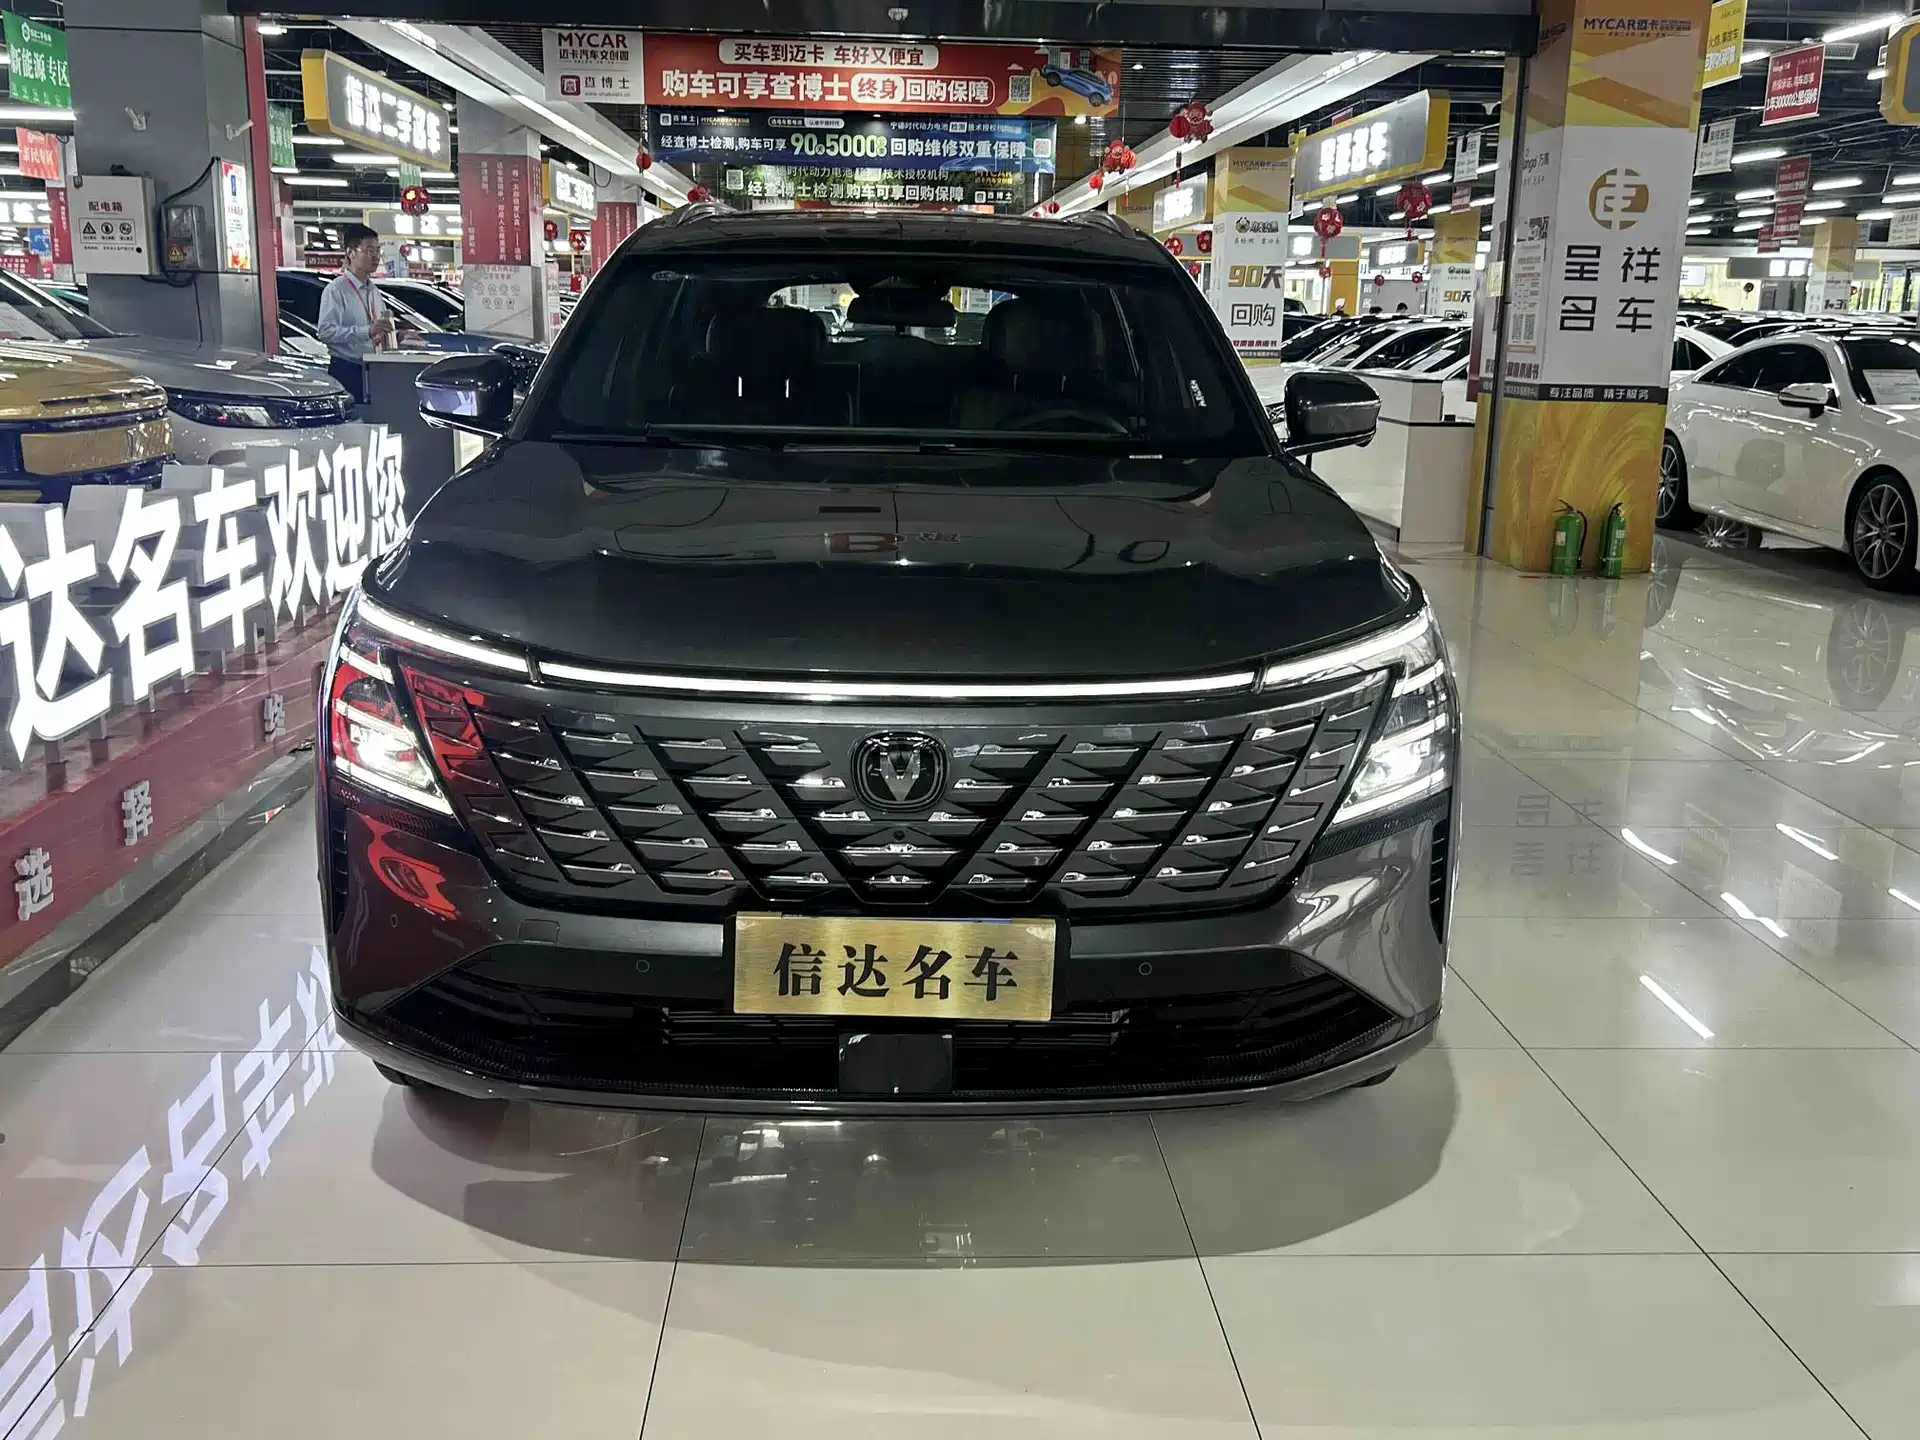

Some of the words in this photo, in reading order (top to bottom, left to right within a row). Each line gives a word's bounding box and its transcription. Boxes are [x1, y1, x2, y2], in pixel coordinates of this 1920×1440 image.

[557, 32, 628, 48] MYCAR
[10, 43, 70, 88] 新能源专区
[734, 43, 825, 64] 买车到迈卡
[834, 45, 924, 66] 车好又便宜
[88, 200, 123, 213] 配电箱
[1564, 243, 1662, 284] 呈祥
[1228, 265, 1283, 288] 90天
[1443, 289, 1472, 303] 90天
[1231, 303, 1277, 327] 回购
[1558, 295, 1655, 334] 名车
[1549, 386, 1595, 399] 专注品质
[1603, 387, 1649, 401] 精于服务
[0, 424, 406, 763] 达名车欢迎您
[773, 942, 1019, 1001] 信达名车
